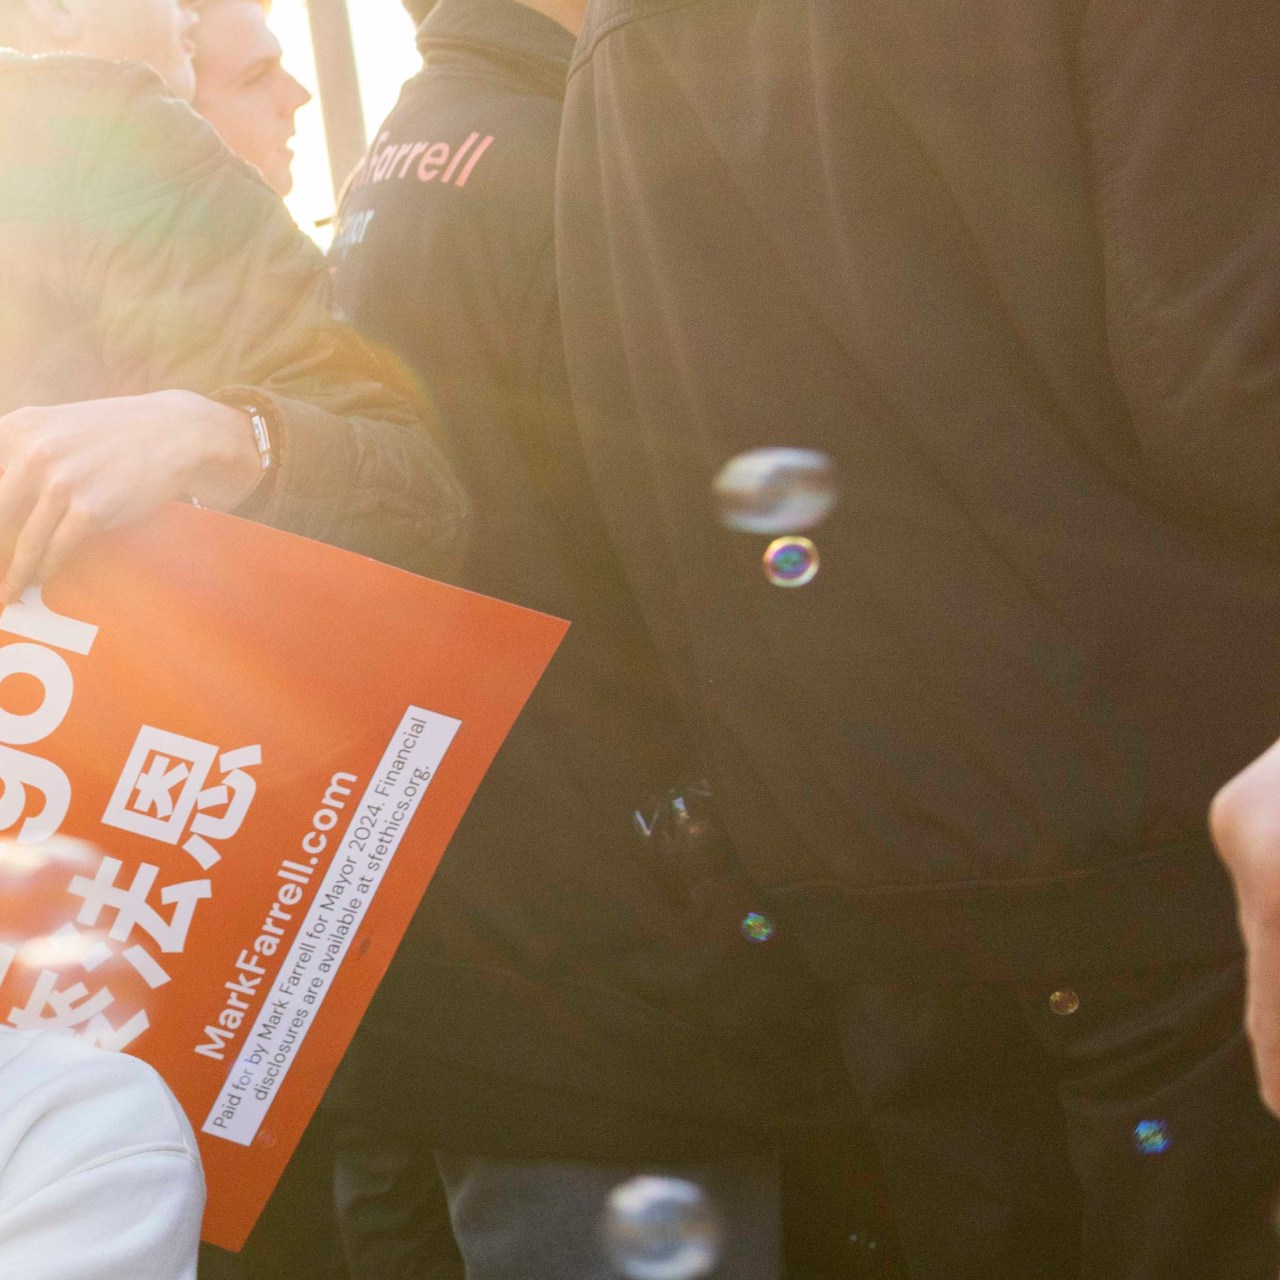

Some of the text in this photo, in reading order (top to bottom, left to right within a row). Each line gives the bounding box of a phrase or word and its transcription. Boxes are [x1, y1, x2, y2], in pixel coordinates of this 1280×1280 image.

[195, 772, 358, 1060] MarkFarrell.com
[213, 717, 427, 1128] Paid for by Mark Farrell for Mayor 2024. Financial
[255, 766, 430, 1101] disclosures are available at sfethics.org.
